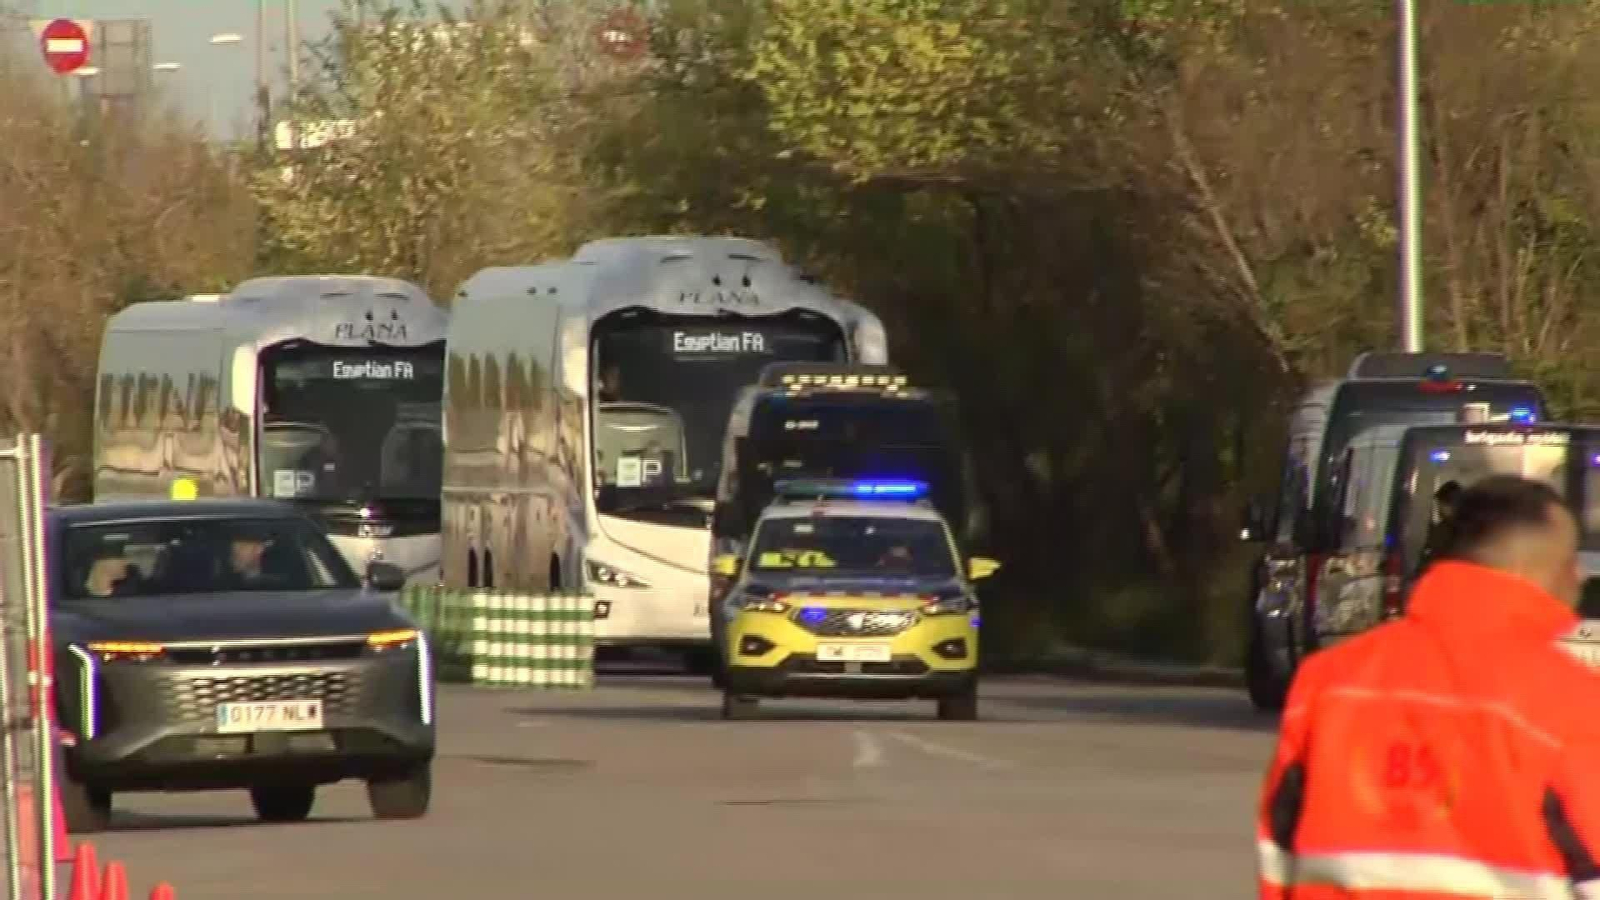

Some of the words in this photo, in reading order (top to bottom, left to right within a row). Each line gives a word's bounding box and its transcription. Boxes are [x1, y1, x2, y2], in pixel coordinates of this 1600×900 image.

[679, 290, 761, 305] PLANA
[334, 322, 407, 340] PLANA
[673, 330, 740, 353] Egyptian
[742, 330, 764, 353] FA
[332, 360, 392, 379] Egyptian
[393, 360, 414, 379] FA
[230, 704, 278, 722] 0177
